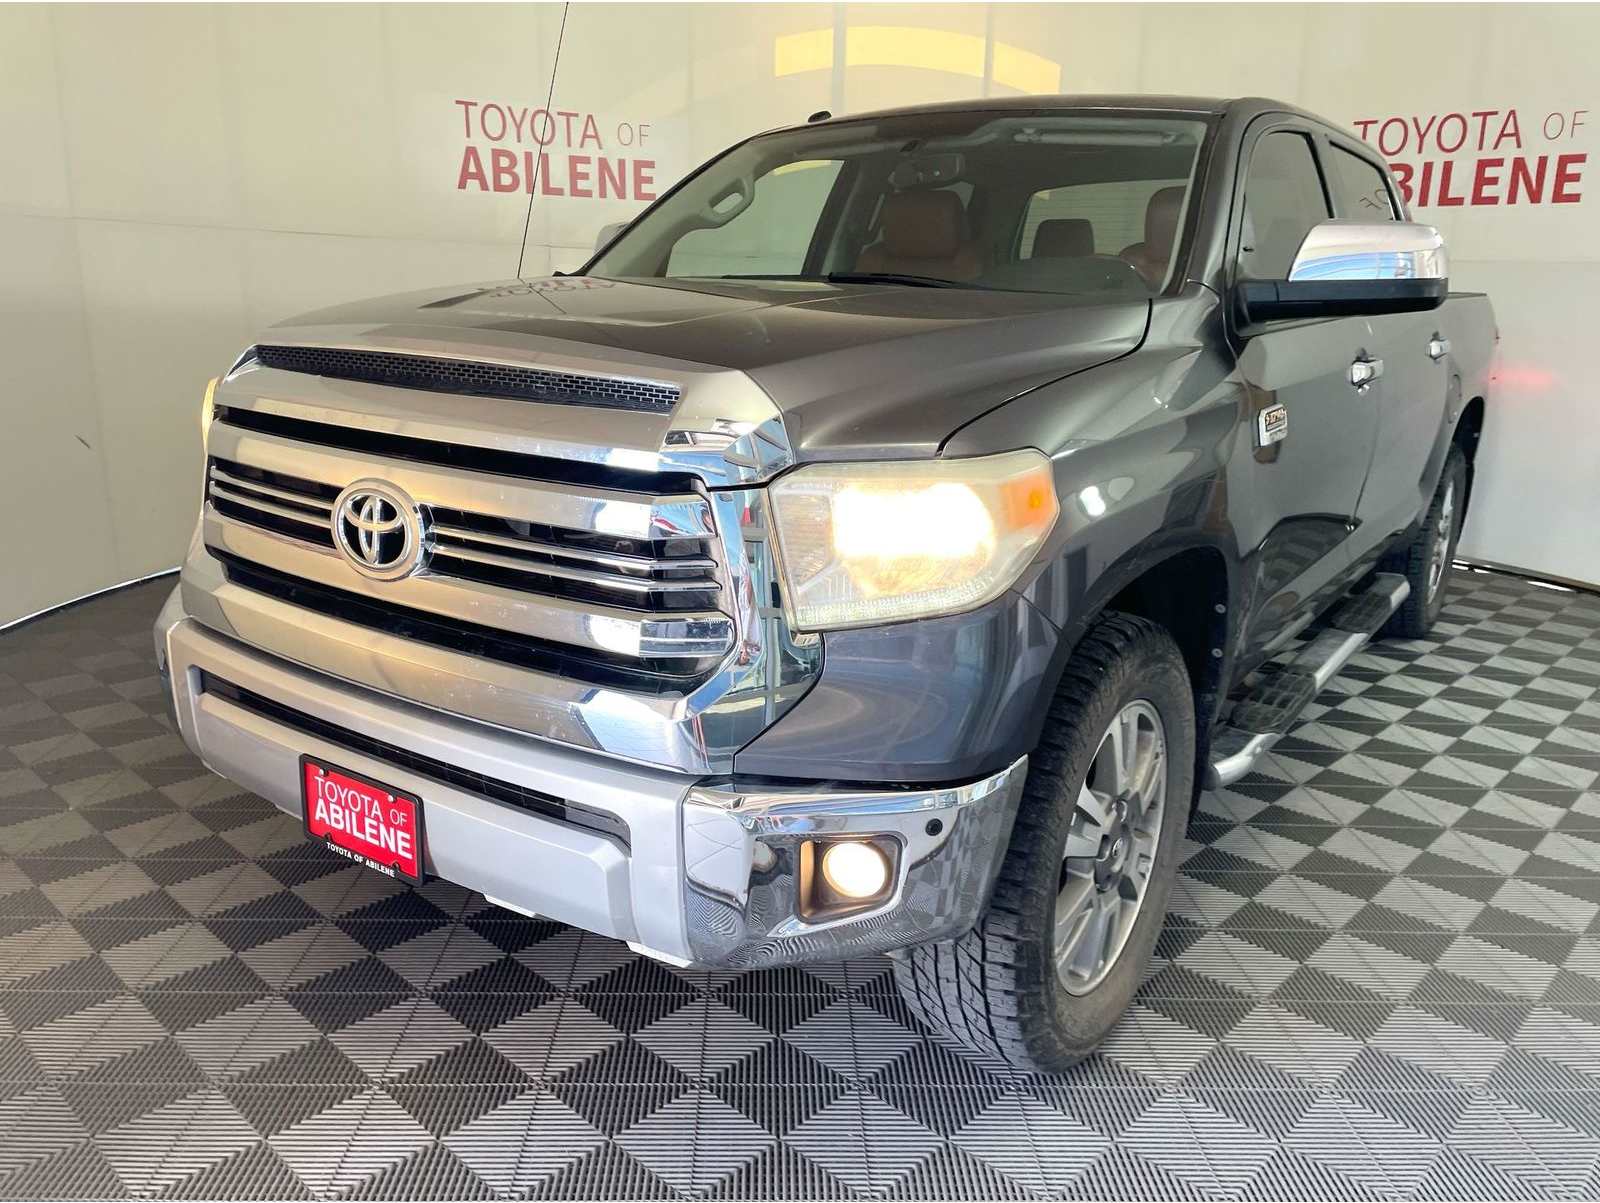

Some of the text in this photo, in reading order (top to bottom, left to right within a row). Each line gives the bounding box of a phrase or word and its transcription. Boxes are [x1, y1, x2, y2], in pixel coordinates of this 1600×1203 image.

[455, 99, 651, 150] TOYOTA OF
[1353, 109, 1589, 156] TOYOTA OF
[457, 145, 657, 201] ABILENE
[1388, 153, 1588, 208] BILENE
[314, 775, 408, 827] TOYOTA OF
[314, 798, 413, 860] ABILENE
[326, 842, 395, 878] TOYOTA OF ABILENE
